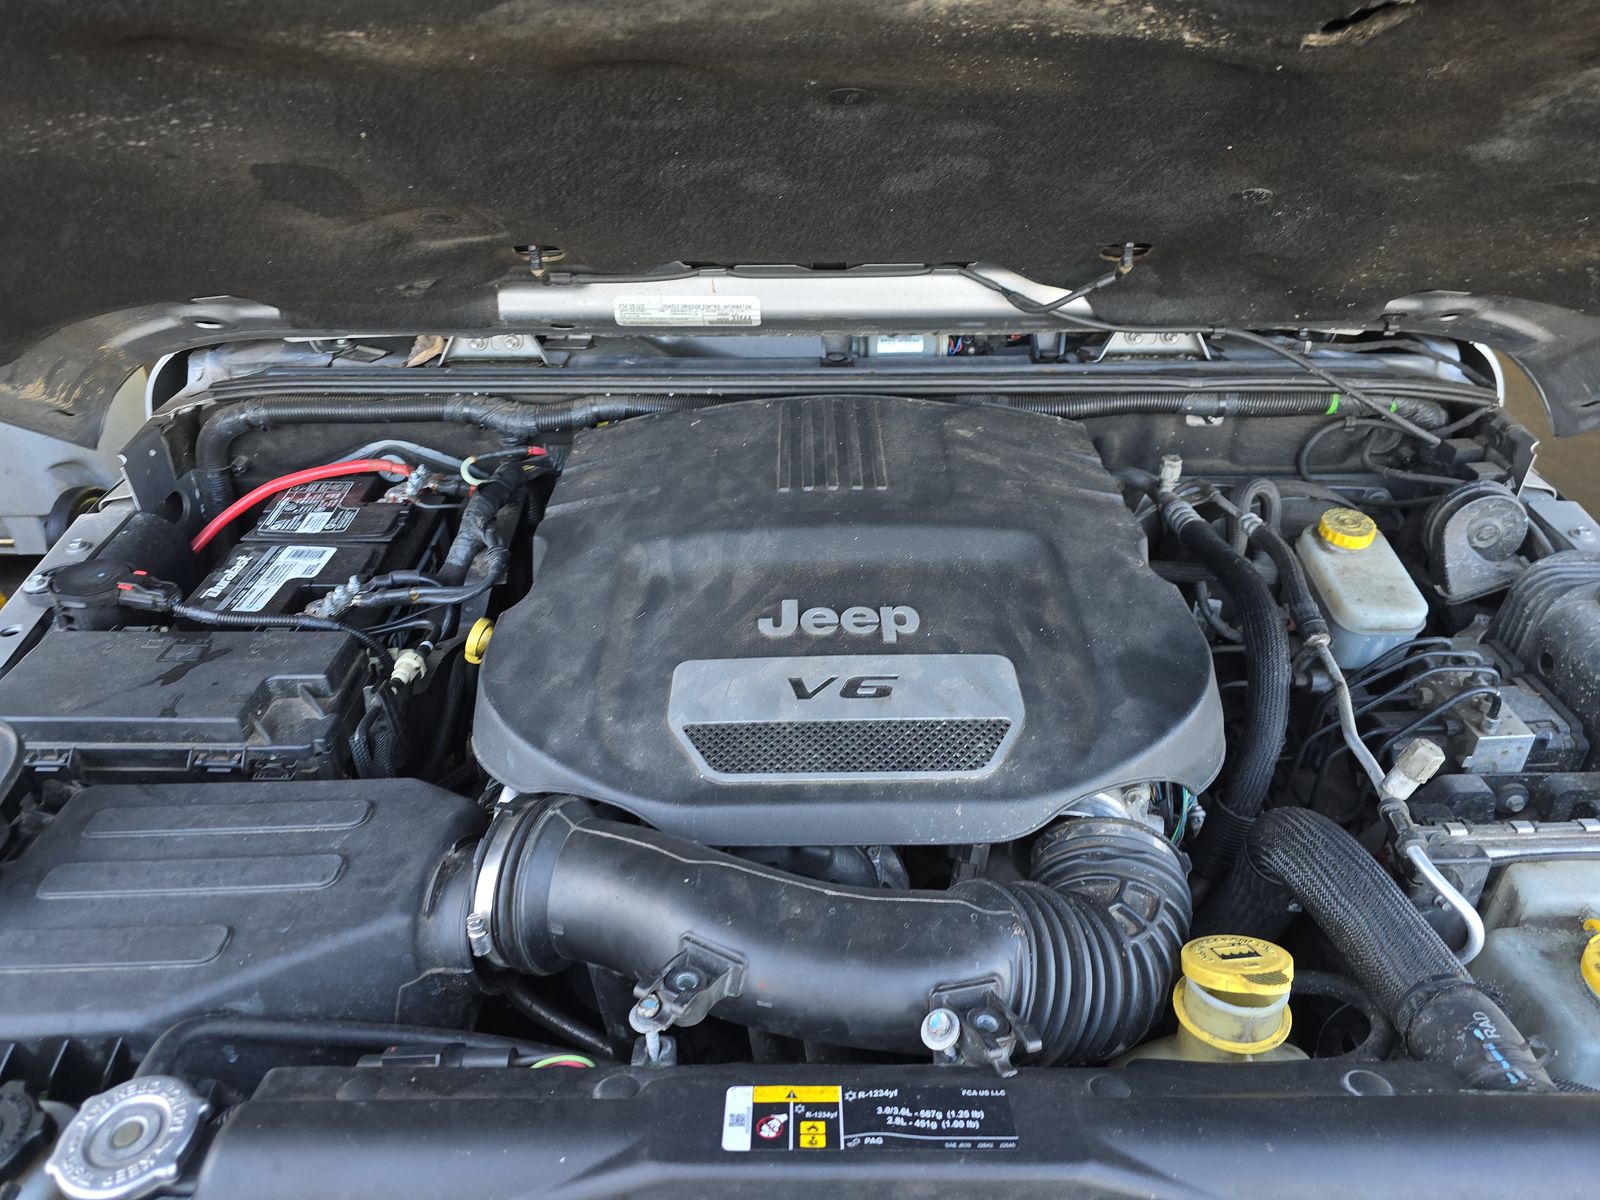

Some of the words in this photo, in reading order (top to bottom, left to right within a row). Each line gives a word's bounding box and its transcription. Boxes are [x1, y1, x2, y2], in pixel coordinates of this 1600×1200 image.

[200, 555, 253, 599] Duralast
[757, 599, 920, 643] Jeep
[788, 674, 899, 700] V6
[113, 1081, 161, 1103] OPEN
[858, 1088, 898, 1099] R-1234yf
[864, 1136, 884, 1145] PAG
[102, 1158, 156, 1187] KEEP
